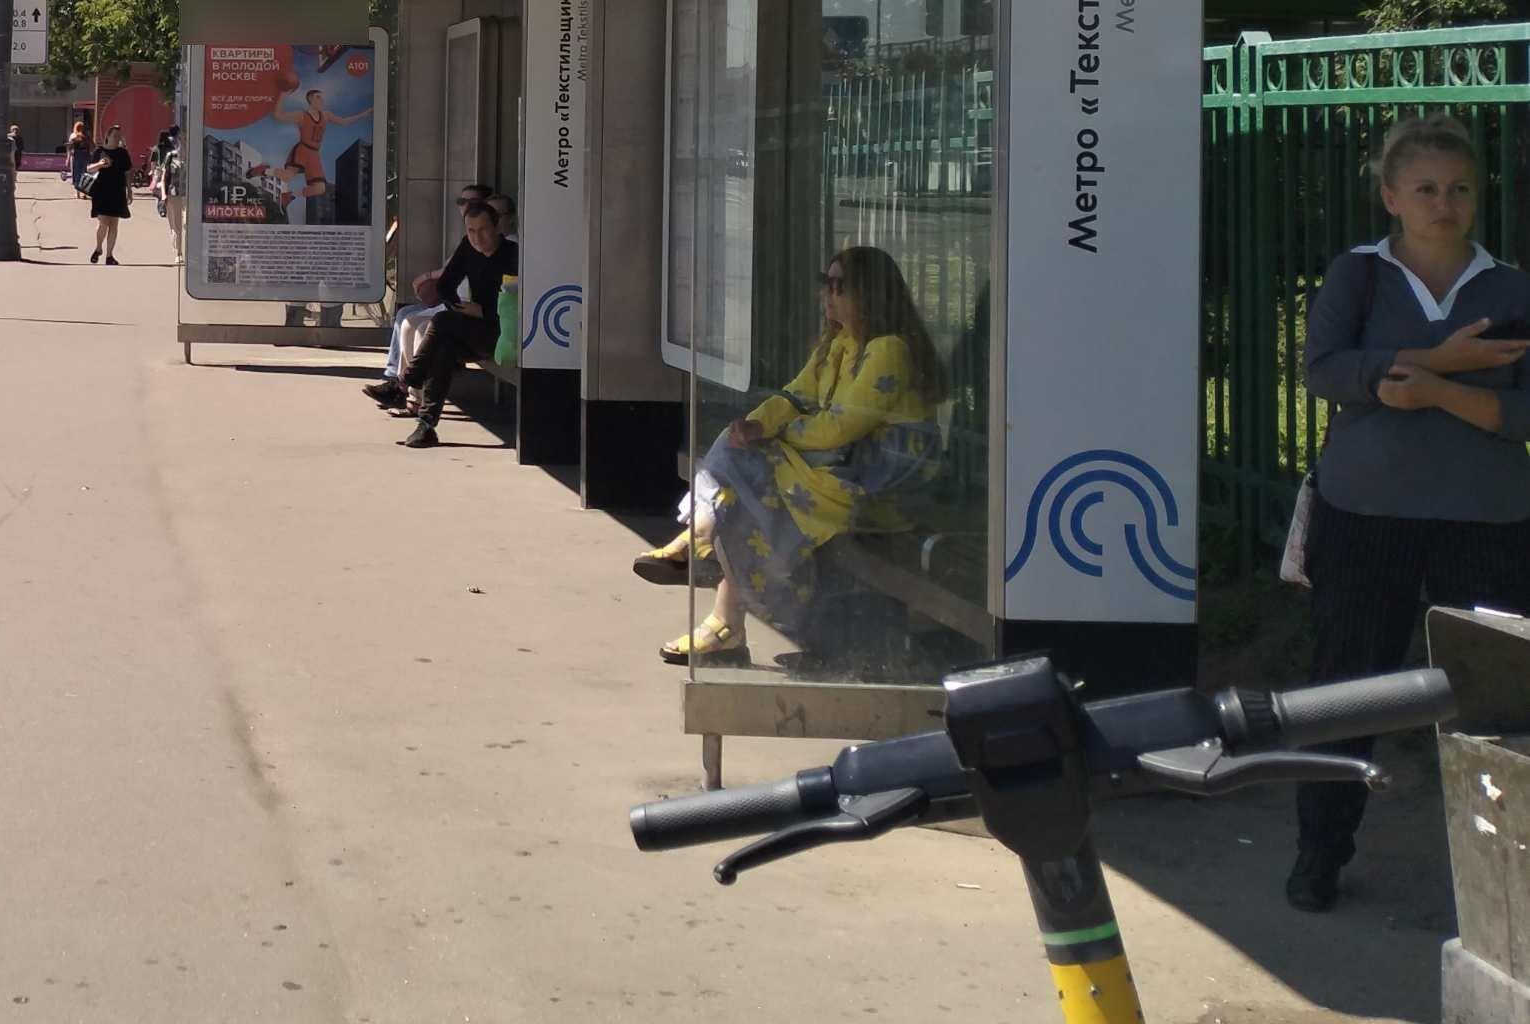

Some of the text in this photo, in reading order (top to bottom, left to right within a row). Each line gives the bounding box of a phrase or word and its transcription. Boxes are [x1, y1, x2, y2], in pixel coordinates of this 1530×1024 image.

[212, 49, 273, 59] КВАРТИРЫ
[212, 61, 280, 72] В МОЛОДОЙ
[577, 45, 588, 81] Metro
[212, 72, 258, 81] МОСКВЕ
[554, 127, 572, 188] Метро
[1068, 129, 1106, 254] Метро
[207, 206, 264, 217] ИПОТЕКА
